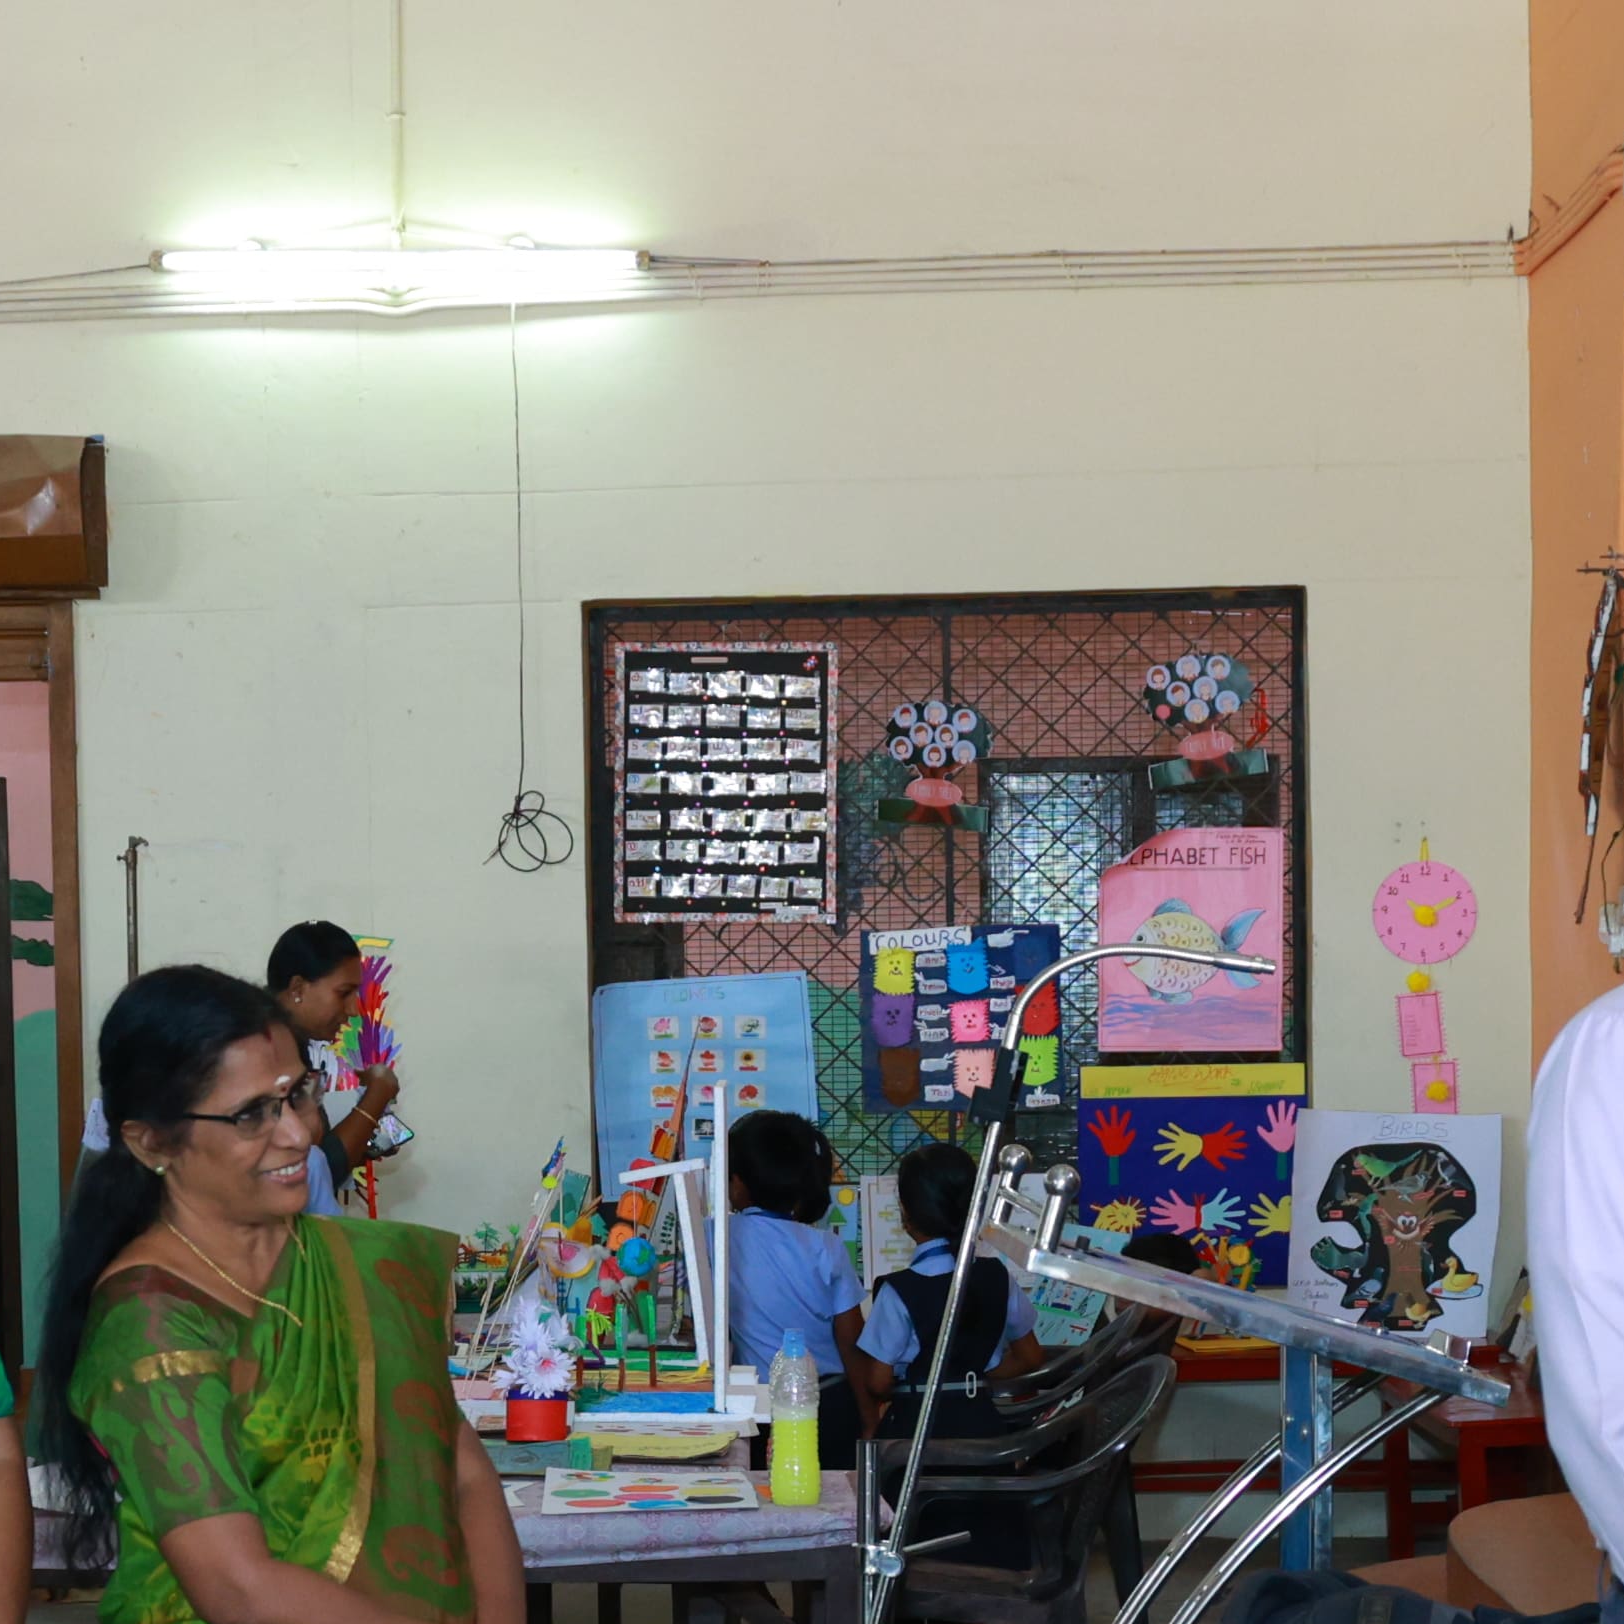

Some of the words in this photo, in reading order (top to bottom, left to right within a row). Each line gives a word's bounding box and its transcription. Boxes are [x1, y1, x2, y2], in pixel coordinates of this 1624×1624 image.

[1126, 847, 1220, 865] LPHABET
[1229, 847, 1266, 865] FISH
[1420, 865, 1431, 876] 12
[1400, 873, 1410, 883] 11
[1443, 873, 1449, 882] 1
[1388, 886, 1398, 896] 10
[1456, 890, 1462, 899] 2
[1381, 905, 1388, 914] 9
[1461, 908, 1467, 917] 3
[1457, 929, 1463, 937] 4
[875, 930, 965, 949] COLOURS
[1400, 942, 1406, 950] 7
[1440, 942, 1445, 950] 5
